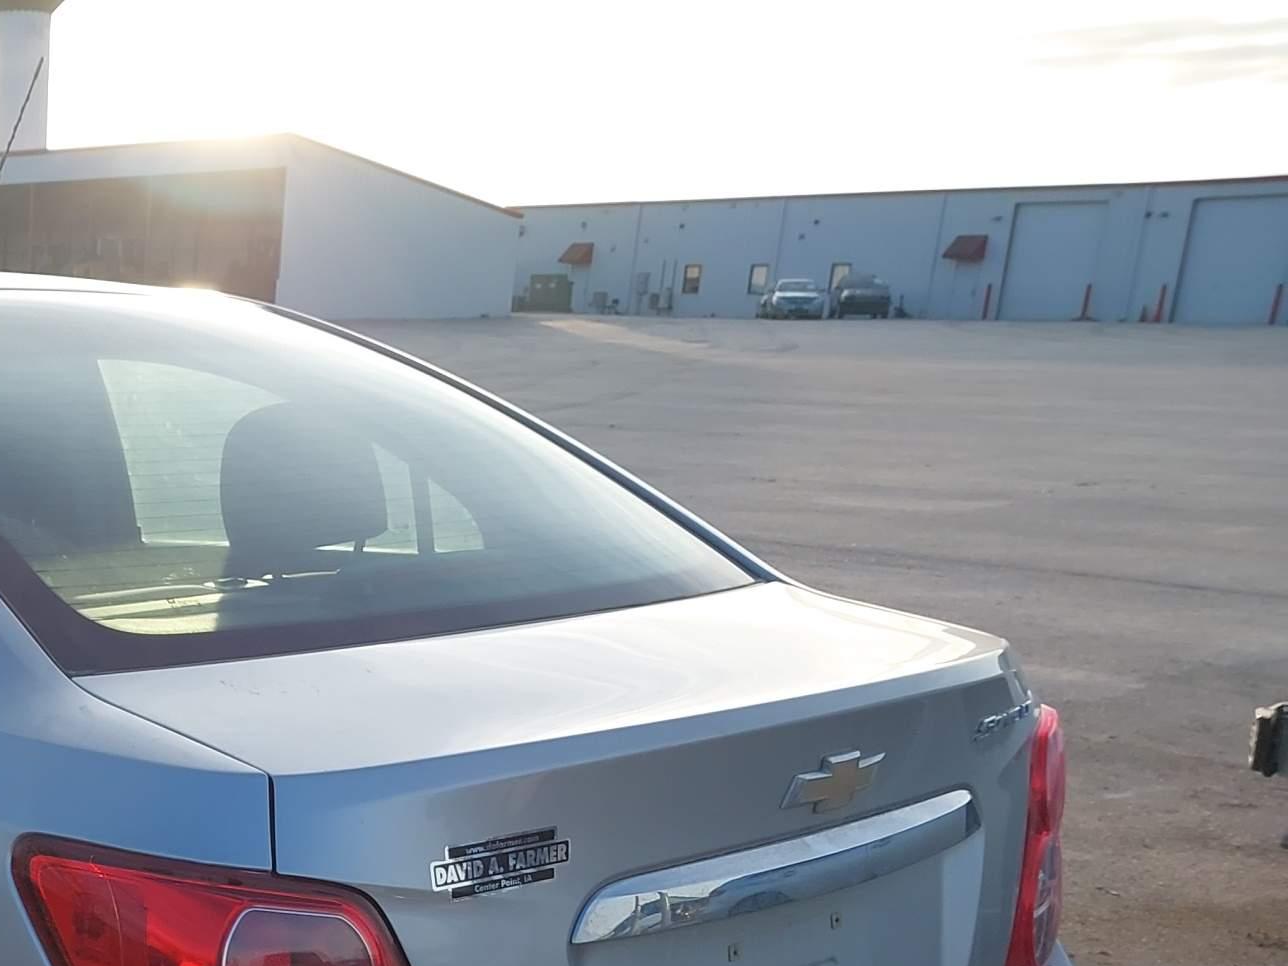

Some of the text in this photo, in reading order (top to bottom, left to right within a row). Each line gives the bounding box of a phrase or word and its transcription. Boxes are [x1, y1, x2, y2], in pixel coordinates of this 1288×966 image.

[435, 843, 568, 886] DAVID A. FARMER
[474, 881, 499, 893] Center
